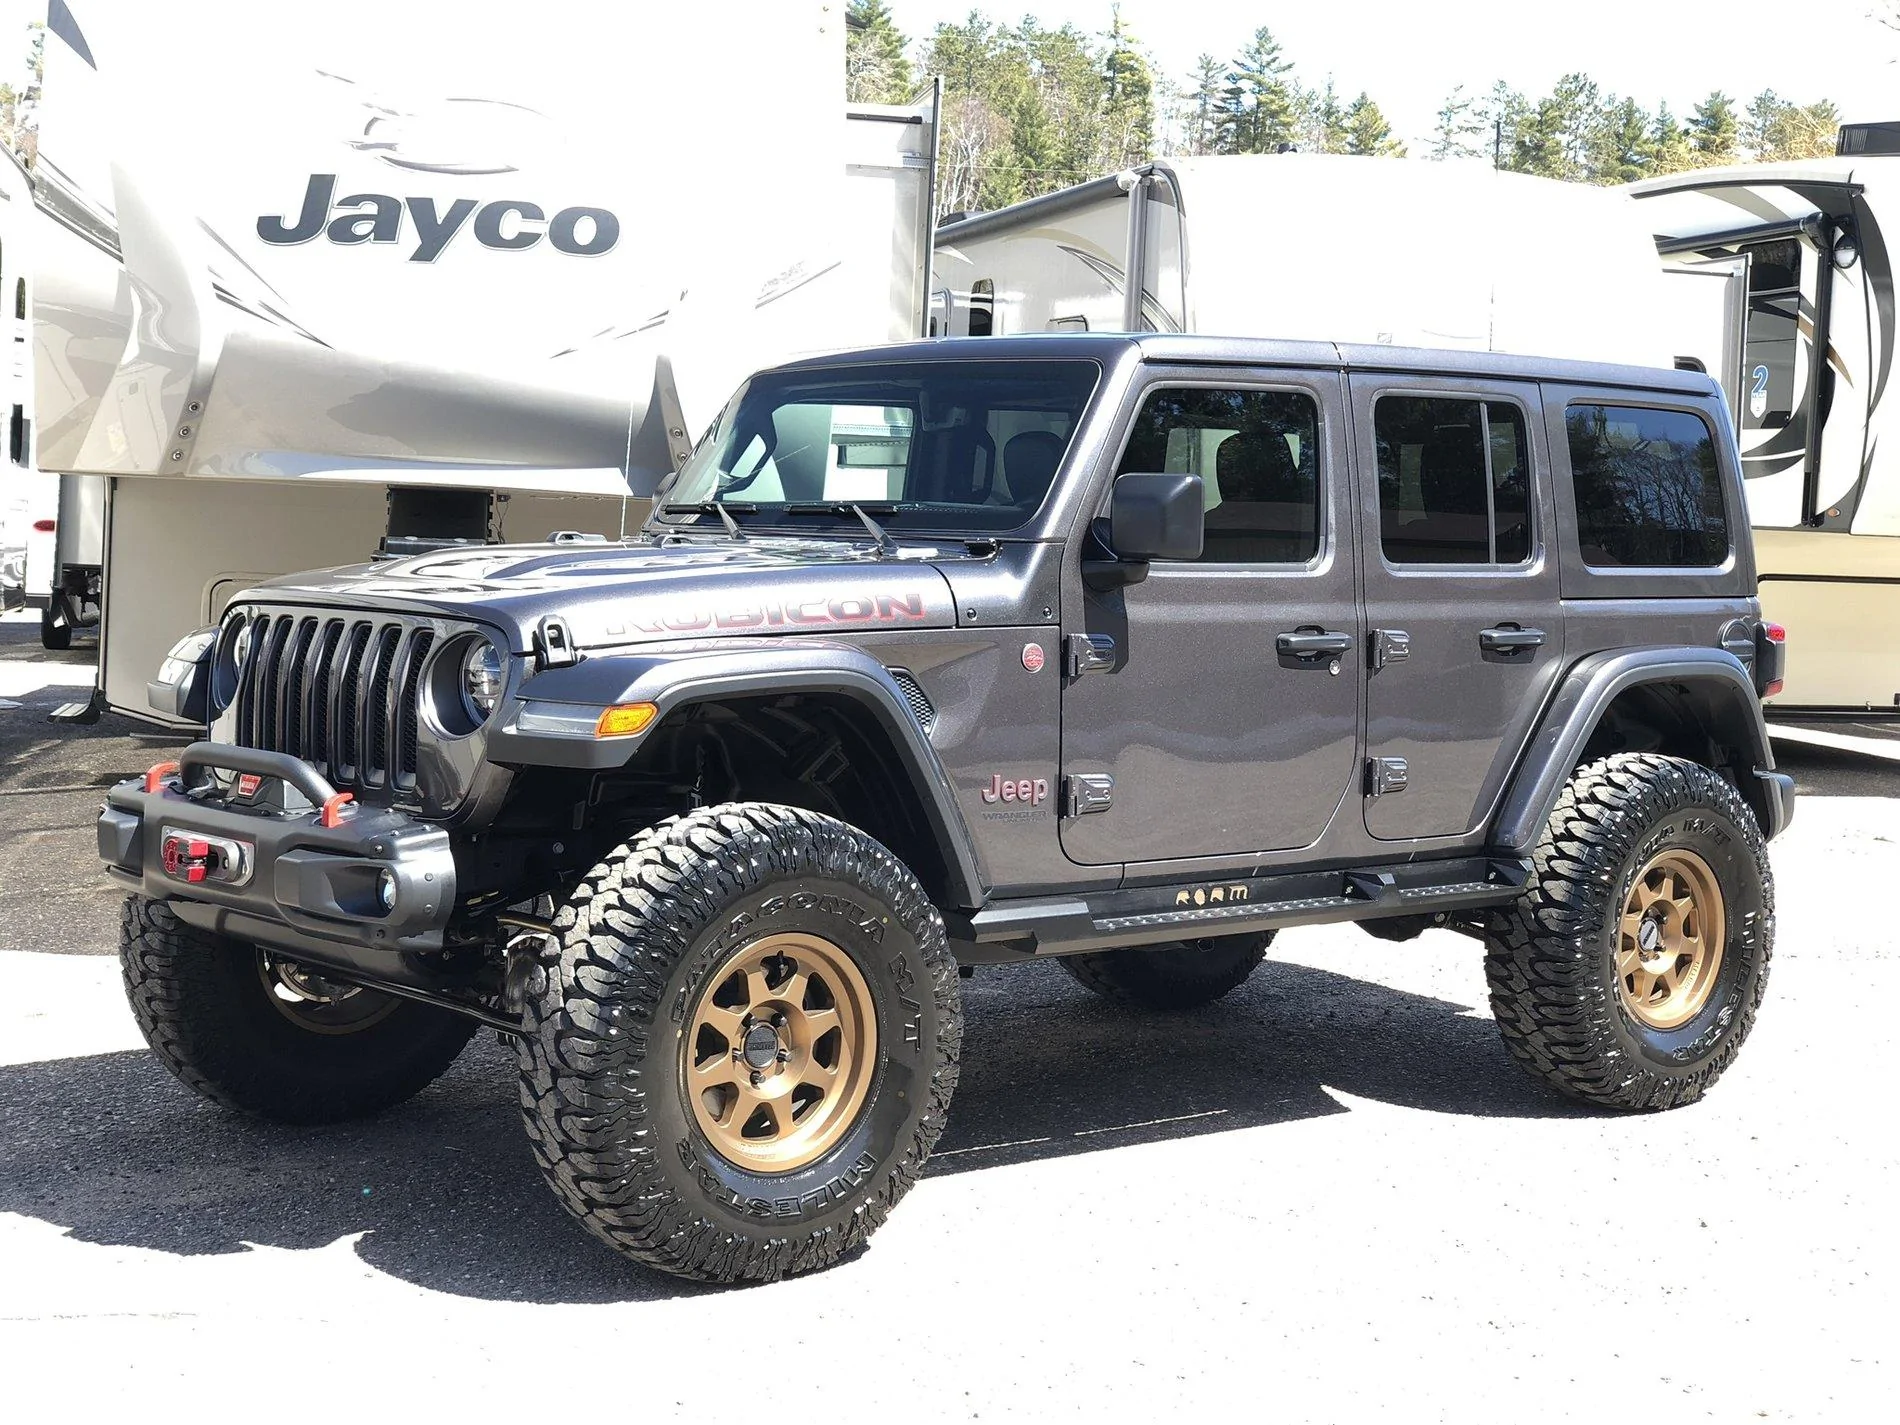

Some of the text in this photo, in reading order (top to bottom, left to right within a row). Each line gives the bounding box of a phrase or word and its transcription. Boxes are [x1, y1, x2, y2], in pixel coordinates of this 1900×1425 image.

[256, 173, 623, 263] Jayco
[1752, 365, 1768, 392] 2
[982, 774, 1048, 806] Jeep
[982, 811, 1047, 821] WRANGLER
[673, 891, 922, 1053] PATAGONIA M/T
[1673, 911, 1756, 1061] MILESTAR
[676, 1137, 878, 1219] MILESTAR
